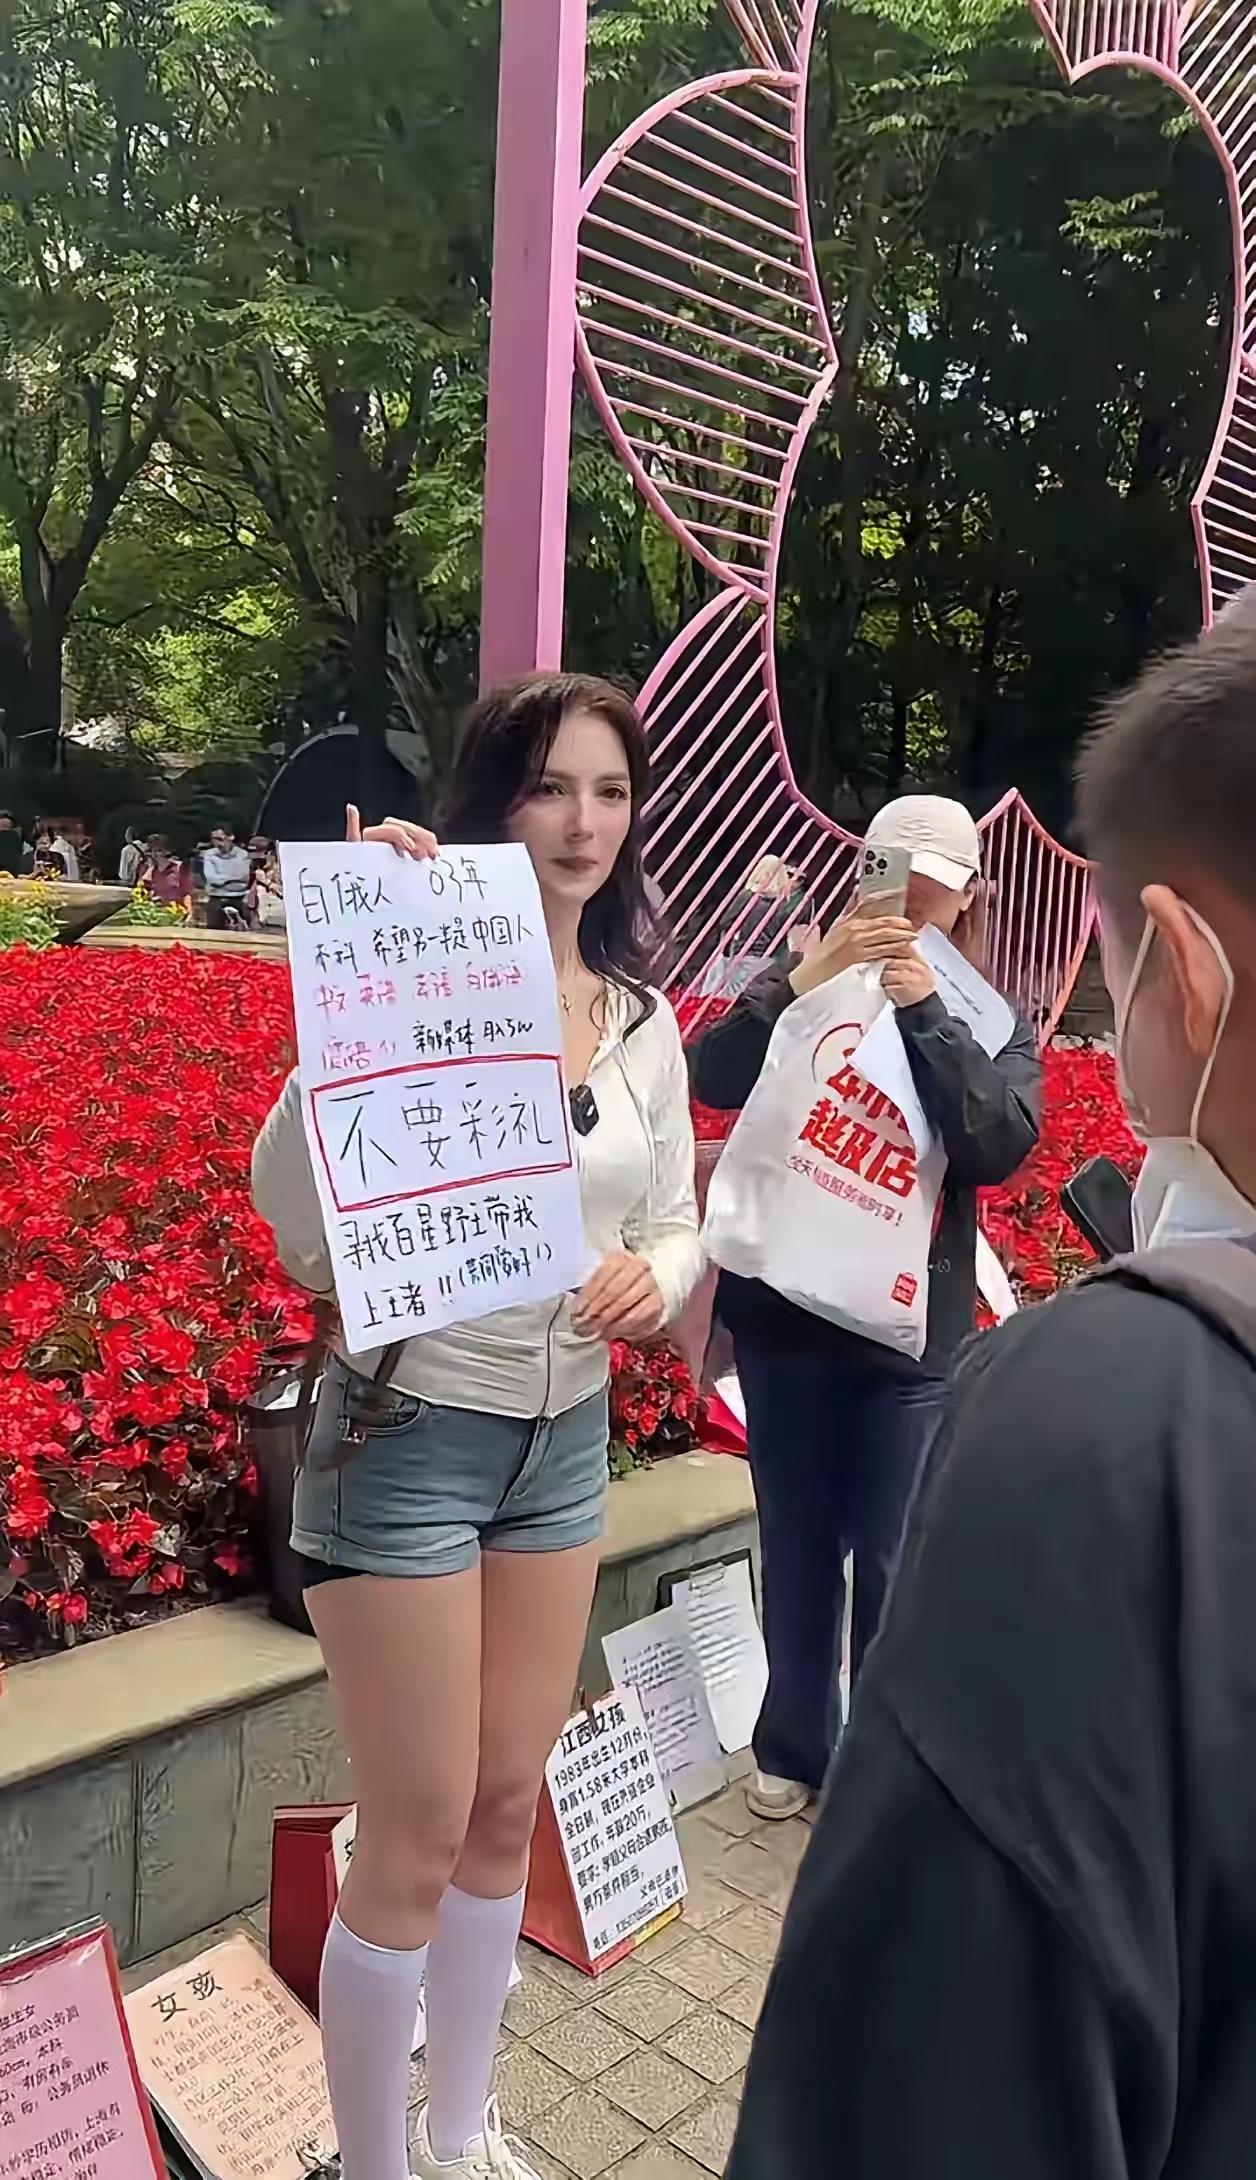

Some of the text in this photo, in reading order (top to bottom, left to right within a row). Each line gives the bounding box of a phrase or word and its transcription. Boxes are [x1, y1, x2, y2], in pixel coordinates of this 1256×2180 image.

[328, 1081, 553, 1188] 不要彩礼
[798, 1096, 918, 1198] 超级店
[150, 1970, 224, 2022] 女孩
